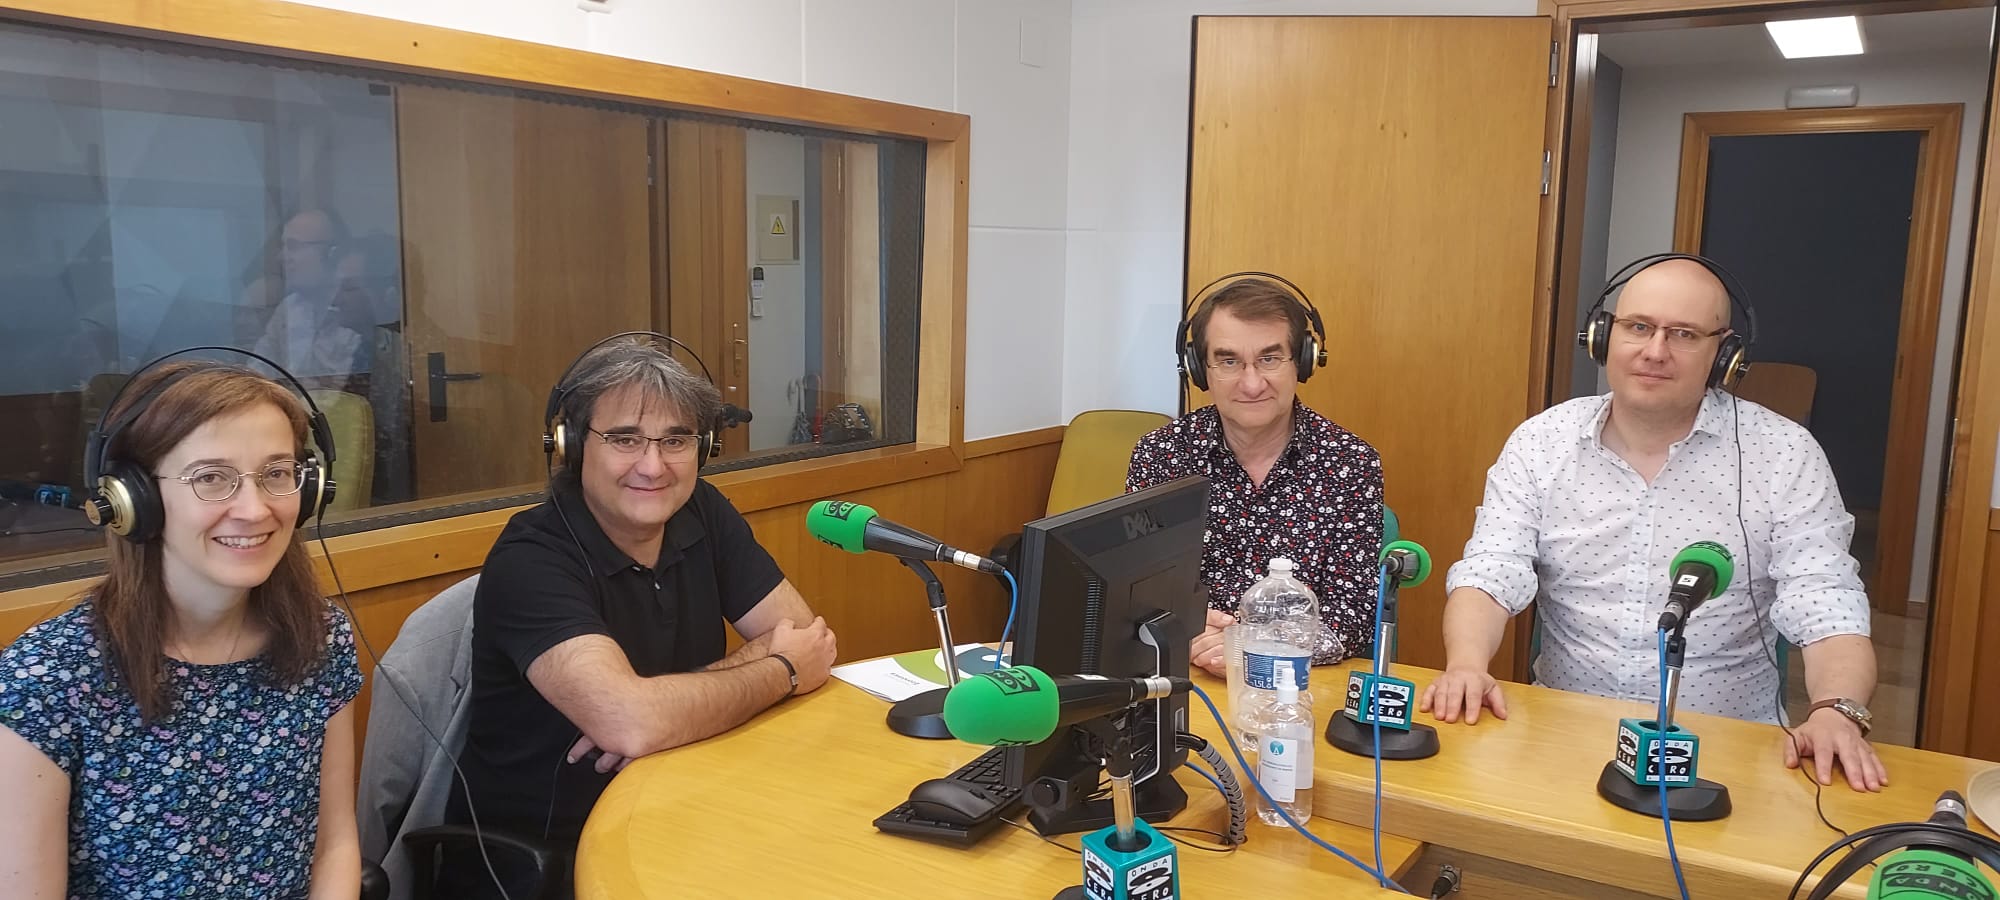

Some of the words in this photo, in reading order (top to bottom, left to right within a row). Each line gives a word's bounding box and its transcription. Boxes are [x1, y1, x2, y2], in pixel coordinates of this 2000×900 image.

[1122, 509, 1166, 540] DELL
[1369, 705, 1402, 716] CERO
[1617, 750, 1635, 768] CERO
[1648, 765, 1687, 774] CRO
[1131, 858, 1168, 878] ONDA
[1132, 887, 1169, 900] ERO
